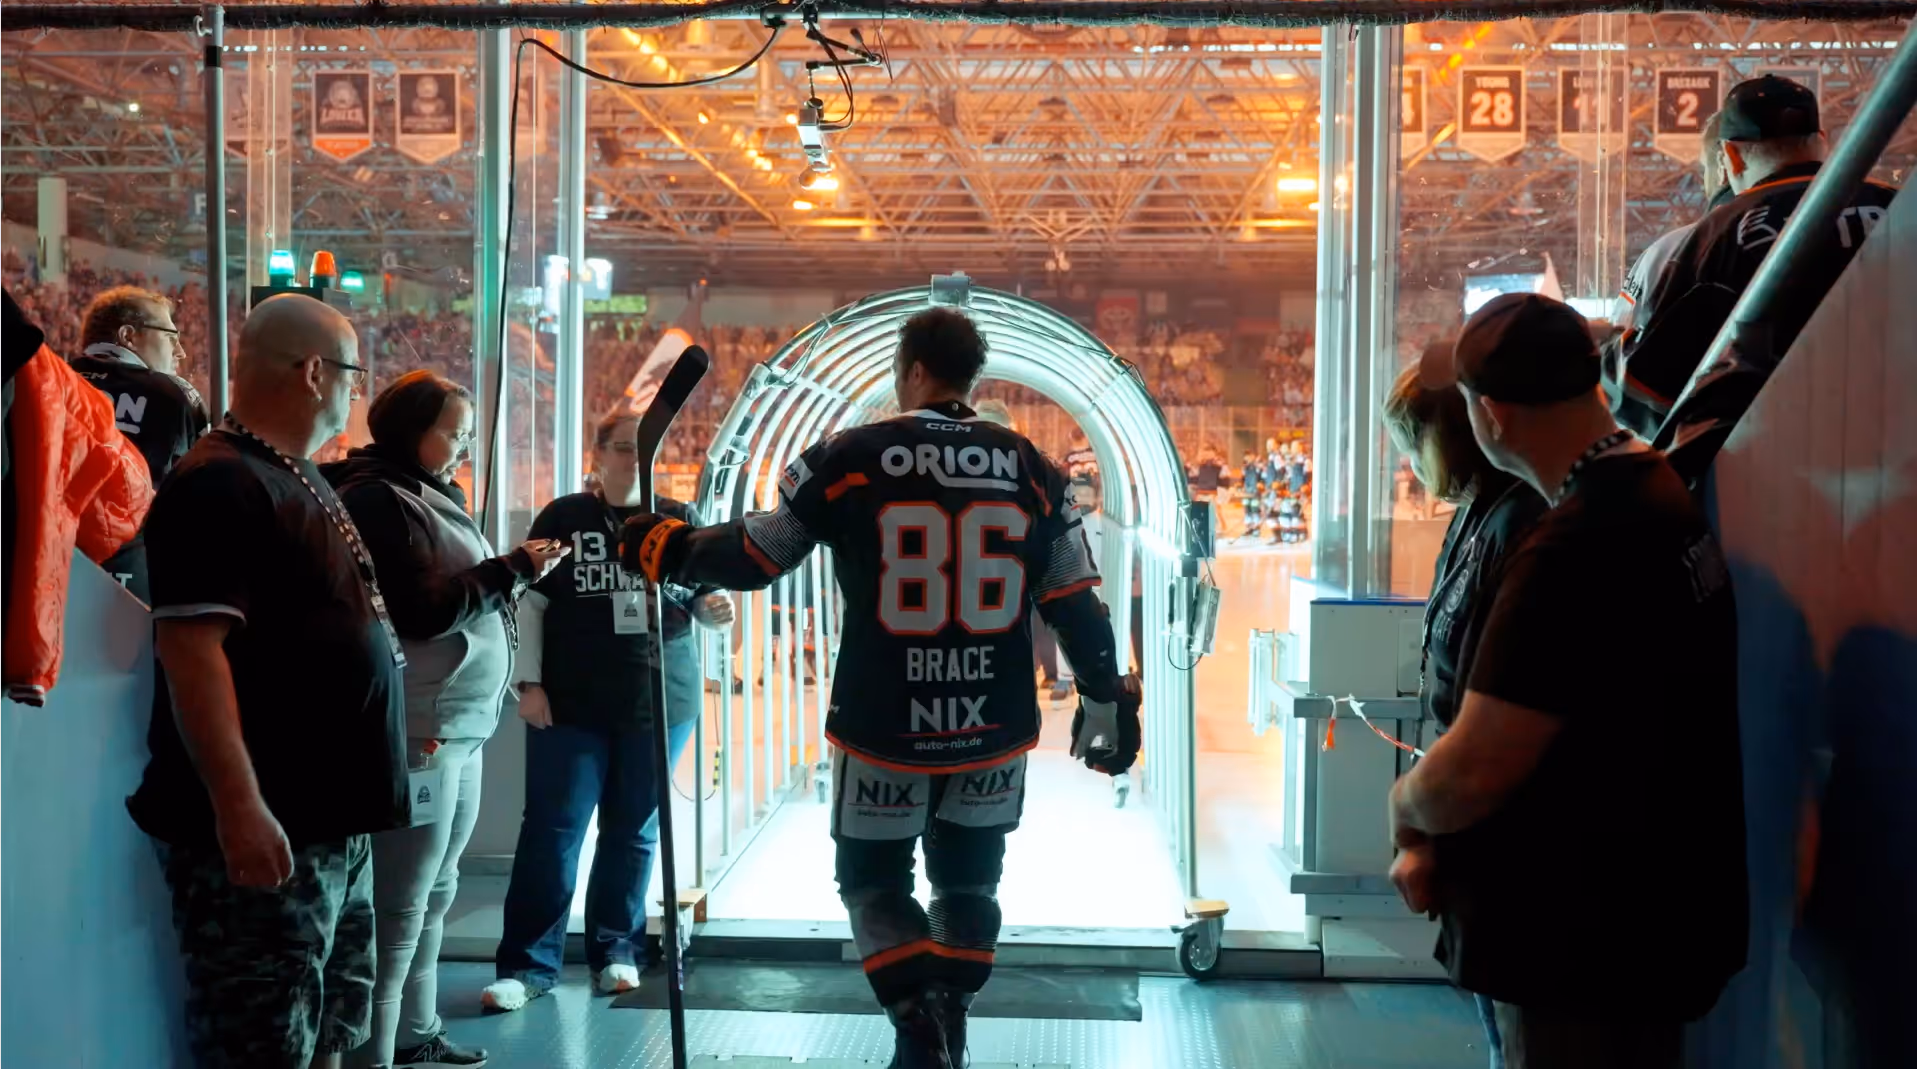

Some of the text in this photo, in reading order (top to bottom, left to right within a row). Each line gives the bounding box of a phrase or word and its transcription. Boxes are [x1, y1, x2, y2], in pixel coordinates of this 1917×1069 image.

[1470, 91, 1514, 126] 28
[1677, 92, 1699, 127] 2
[926, 422, 973, 433] CCM
[880, 443, 1020, 491] ORION
[571, 531, 607, 562] 13
[877, 500, 1032, 636] 86
[906, 645, 995, 682] BRACE
[910, 695, 988, 733] NIX
[914, 737, 983, 751] auto-nix.de
[855, 777, 915, 806] NIX
[960, 768, 1017, 796] NIX
